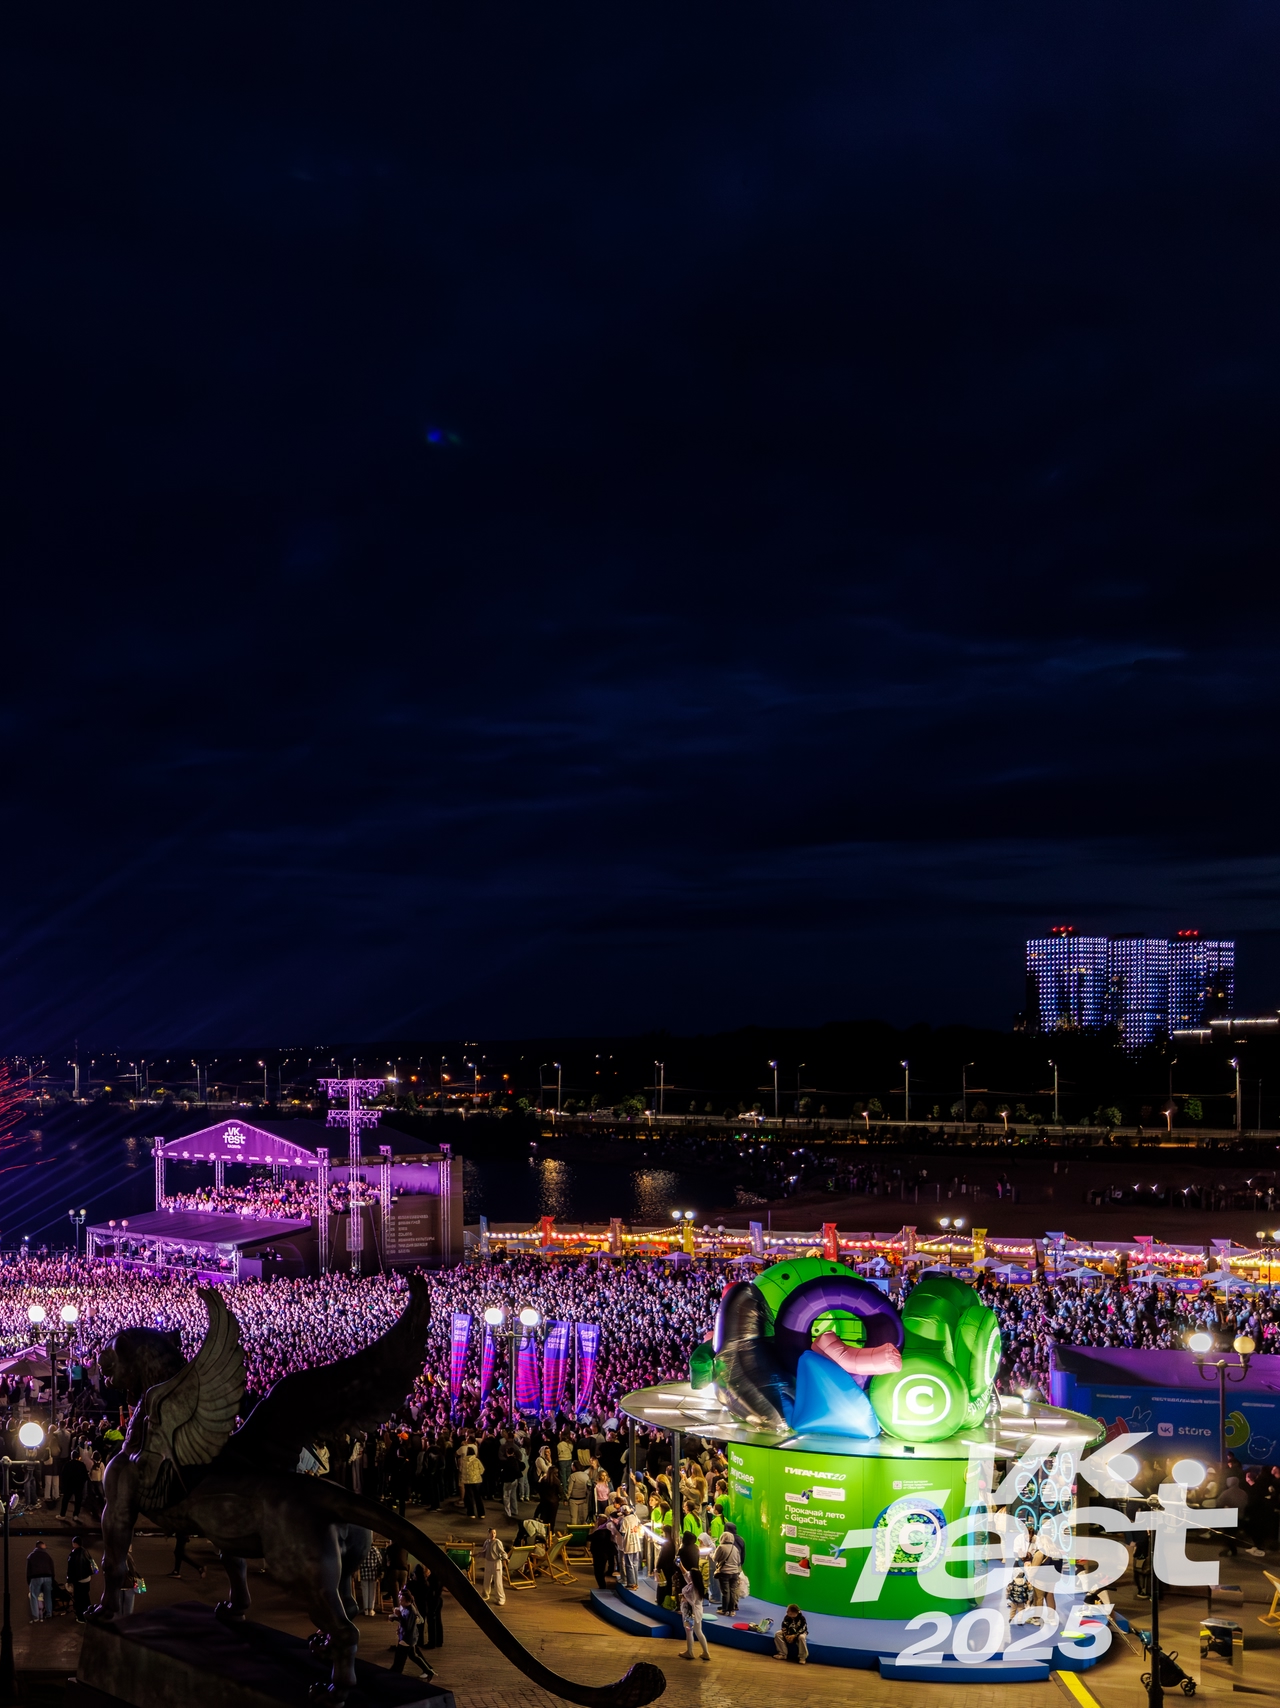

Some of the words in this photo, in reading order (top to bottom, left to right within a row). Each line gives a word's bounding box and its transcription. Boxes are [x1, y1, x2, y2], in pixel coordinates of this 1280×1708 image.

[228, 1127, 240, 1135] VK
[223, 1132, 246, 1144] fest
[1178, 1427, 1212, 1437] store
[785, 1504, 824, 1518] Прокачай
[825, 1511, 846, 1520] лето
[791, 1514, 828, 1526] GigaChat
